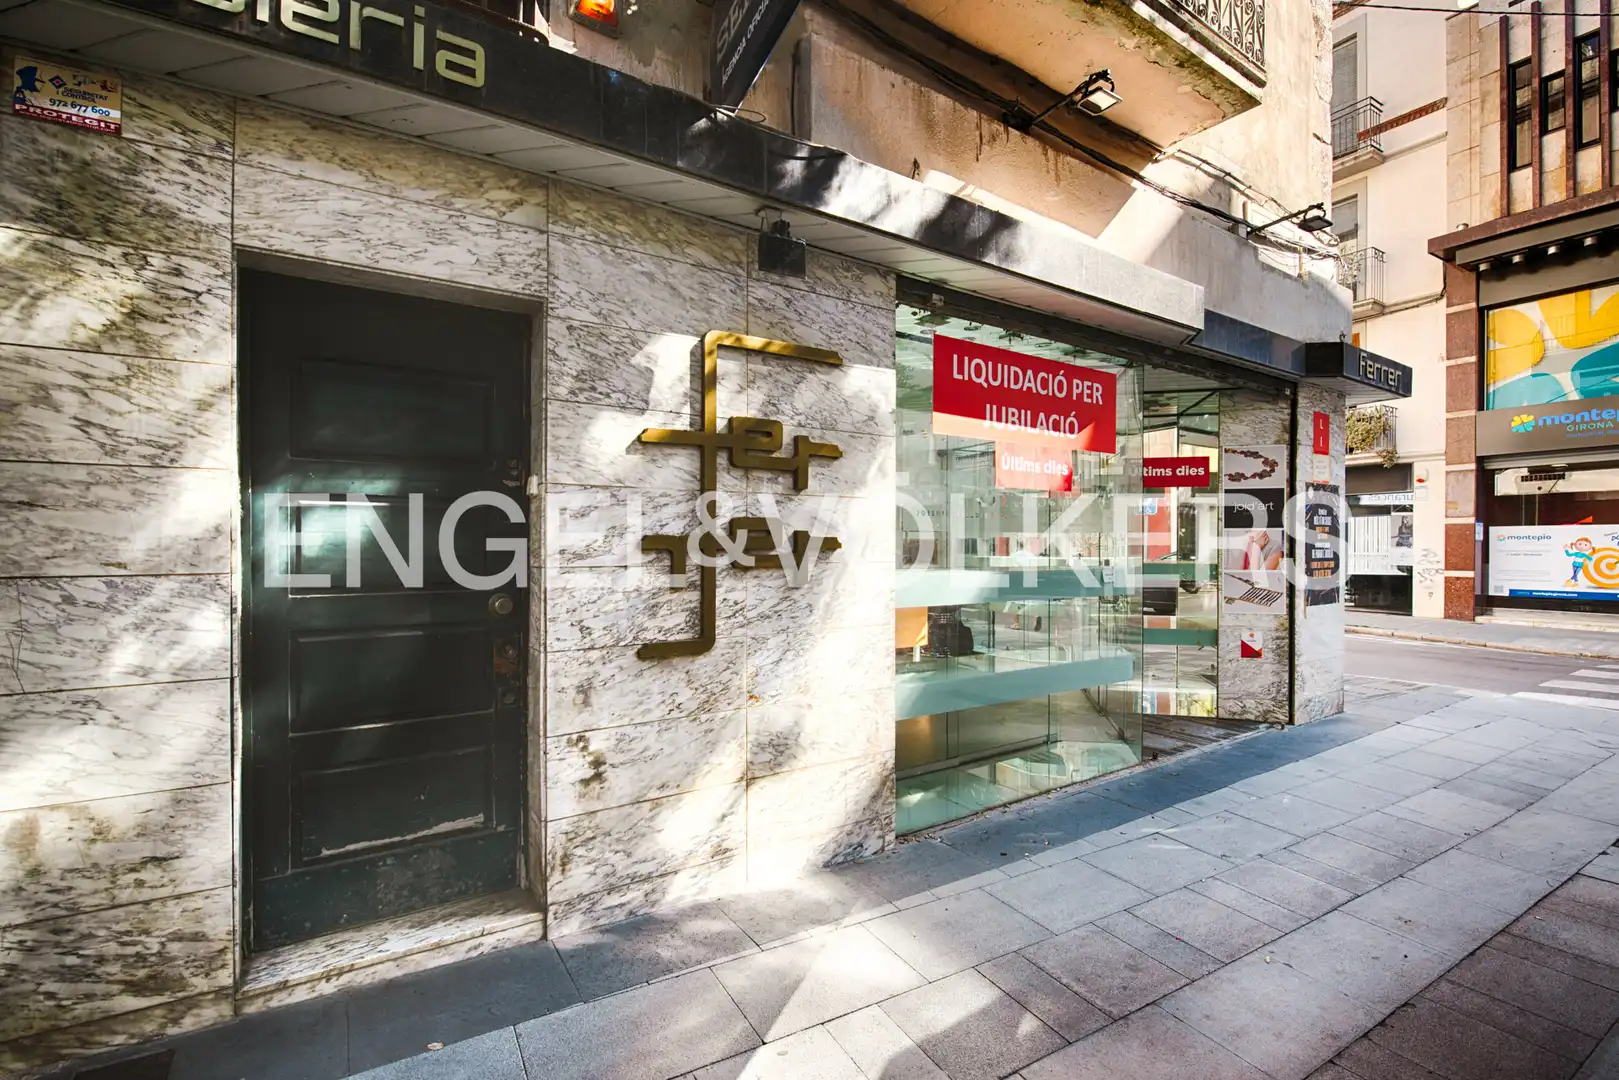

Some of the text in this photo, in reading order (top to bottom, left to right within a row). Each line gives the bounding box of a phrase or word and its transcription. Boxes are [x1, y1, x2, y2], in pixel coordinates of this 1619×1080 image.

[15, 103, 120, 130] PROTEGIT
[49, 98, 110, 117] 972 677 600
[952, 353, 1103, 405] LIQUIDACIÓ PER
[1360, 352, 1402, 387] Ferrer
[984, 403, 1079, 439] JUBILACIÓ
[1566, 421, 1614, 432] GIRONA
[1001, 452, 1069, 476] Últims dies
[1175, 465, 1205, 476] dies
[1507, 533, 1552, 542] montepio
